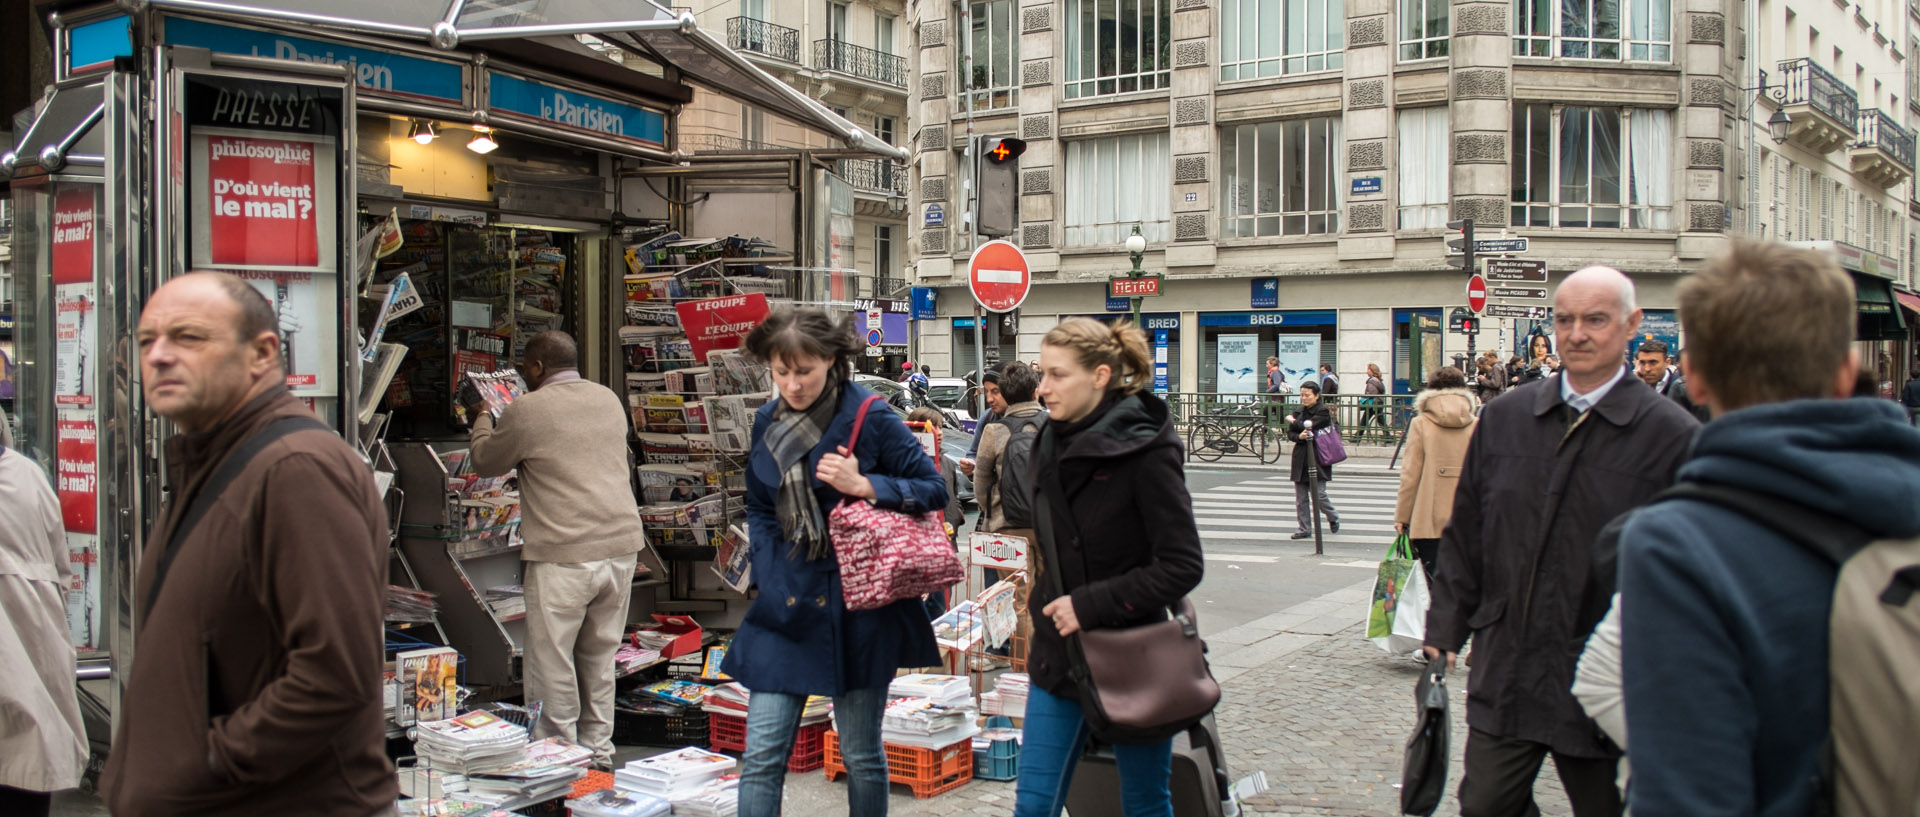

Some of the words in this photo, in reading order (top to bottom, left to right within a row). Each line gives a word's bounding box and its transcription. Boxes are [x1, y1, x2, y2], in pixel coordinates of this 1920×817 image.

[211, 87, 313, 129] PRESSE
[541, 98, 551, 120] le
[554, 93, 623, 136] Parisien
[211, 140, 311, 164] philosophie
[214, 179, 258, 196] D'où
[261, 181, 312, 198] vient
[1186, 193, 1196, 201] 22
[215, 195, 240, 216] le
[55, 211, 73, 226] D'où
[73, 207, 93, 223] vient
[53, 225, 64, 244] le
[696, 297, 746, 311] L'EQUIPE
[704, 321, 755, 335] L'EQUIPE
[1148, 318, 1178, 329] BRED
[1250, 315, 1283, 325] BRED
[467, 329, 504, 354] Marianne
[467, 371, 492, 379] marie
[491, 368, 519, 378] claire
[648, 409, 680, 418] Demy
[59, 426, 95, 444] philosophie
[59, 459, 75, 473] D'où
[76, 458, 95, 474] vient
[59, 475, 67, 491] le
